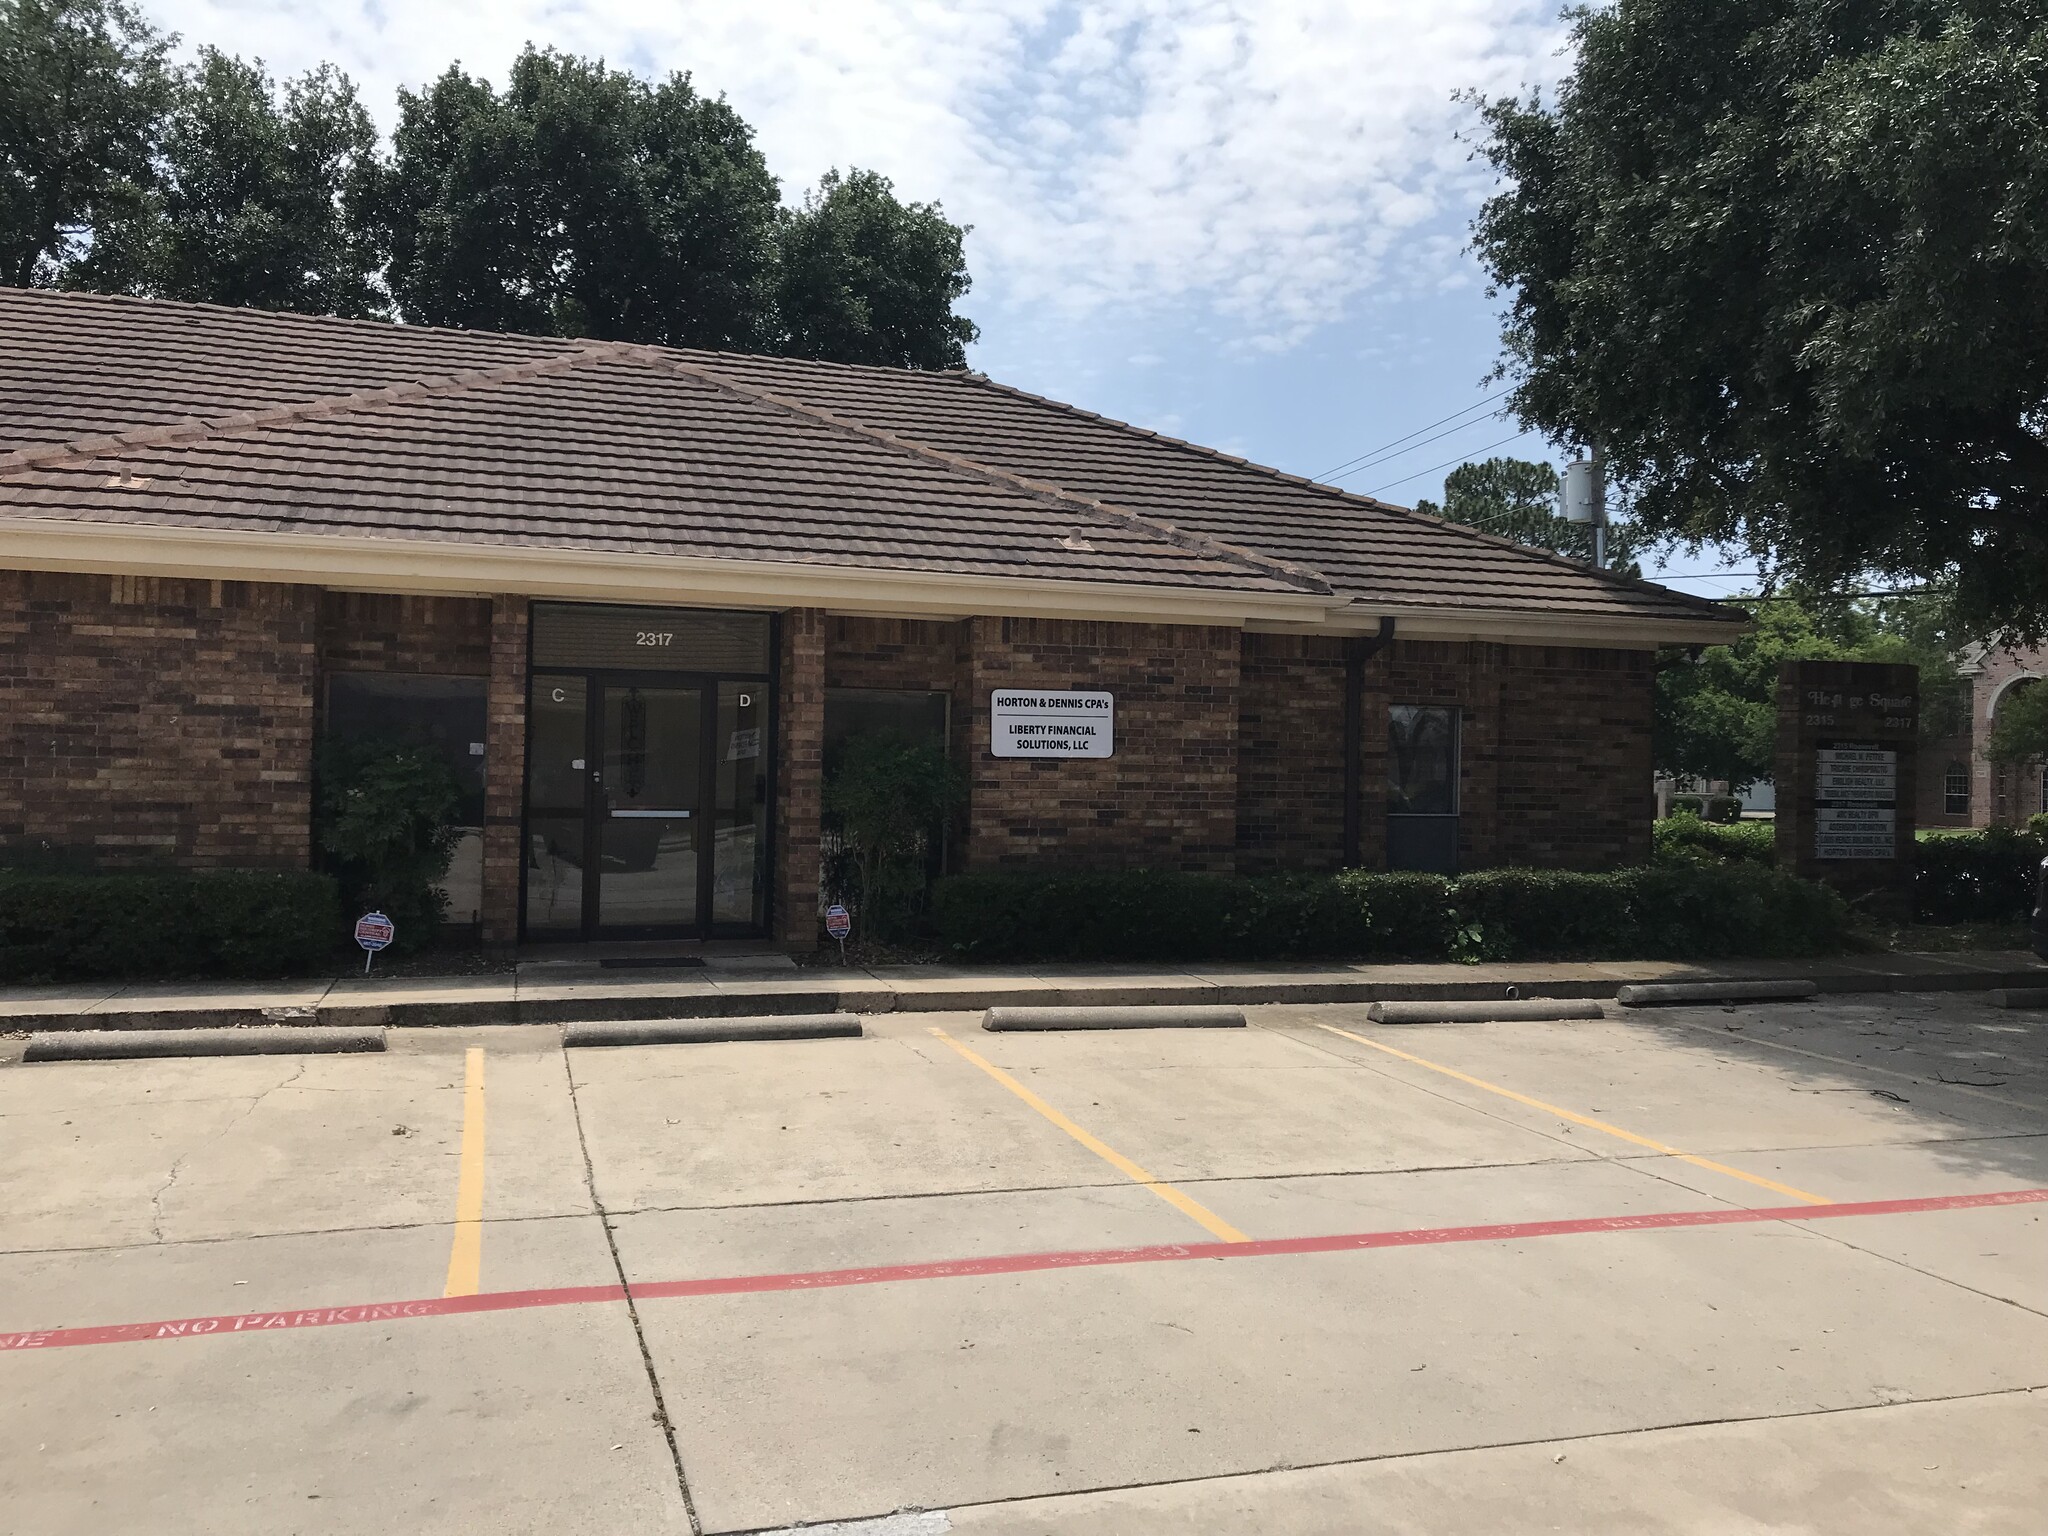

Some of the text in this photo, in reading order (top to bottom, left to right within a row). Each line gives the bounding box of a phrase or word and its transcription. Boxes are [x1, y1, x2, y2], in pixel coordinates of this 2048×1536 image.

[636, 632, 673, 646] 2317
[552, 688, 565, 702] C
[739, 694, 751, 707] D
[997, 697, 1109, 709] HORTON & DENNIS CPA's
[1806, 714, 1834, 727] 2315
[1885, 716, 1912, 728] 2317
[1009, 725, 1096, 736] LIBERTY FINANCIAL
[1016, 740, 1089, 751] SOLUTIONS, LLC
[155, 1319, 217, 1337] NO
[233, 1303, 434, 1330] PARKING
